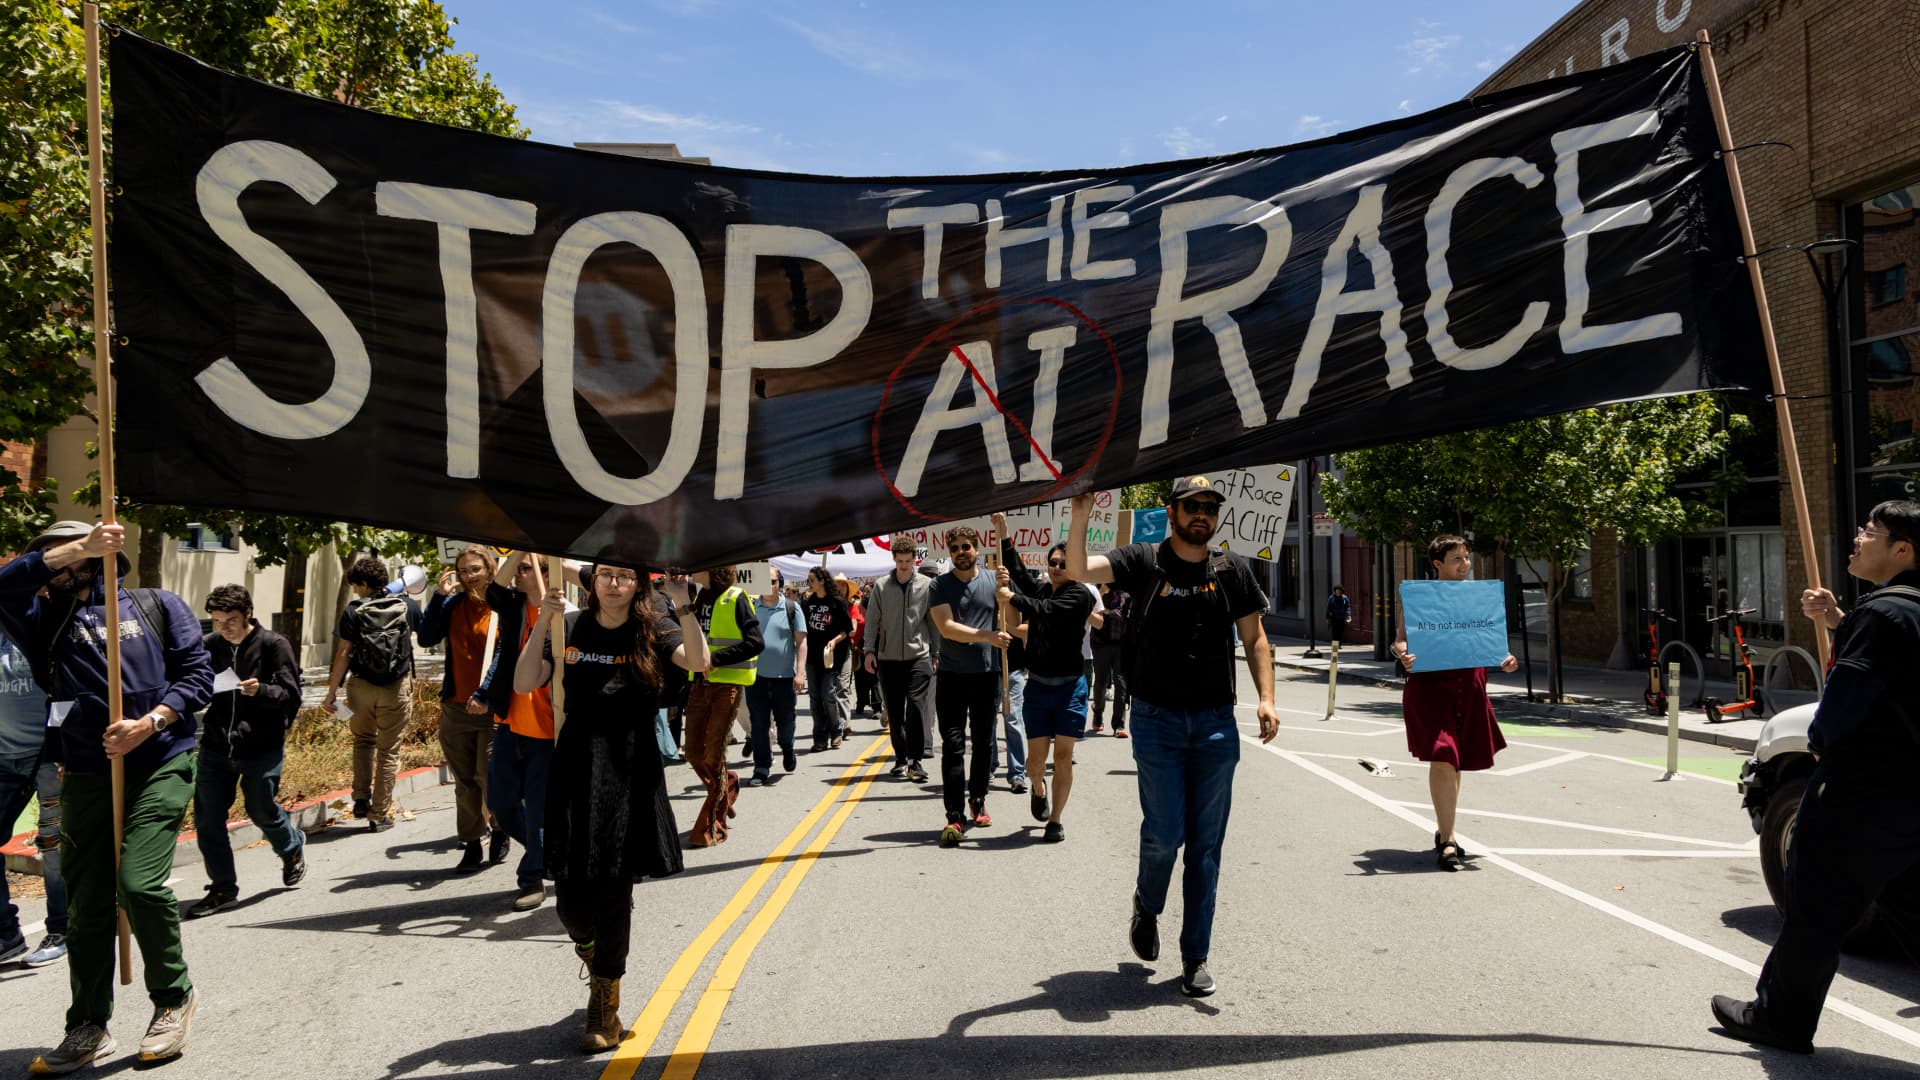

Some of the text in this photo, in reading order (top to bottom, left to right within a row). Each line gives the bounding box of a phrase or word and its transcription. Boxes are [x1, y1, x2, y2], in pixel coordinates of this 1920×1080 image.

[195, 109, 1683, 506] STOP THE AI RACE
[1240, 473, 1283, 506] Race
[1061, 506, 1113, 524] FURE
[1059, 521, 1115, 543] HMAN
[1429, 622, 1436, 631] is
[1439, 620, 1453, 630] not
